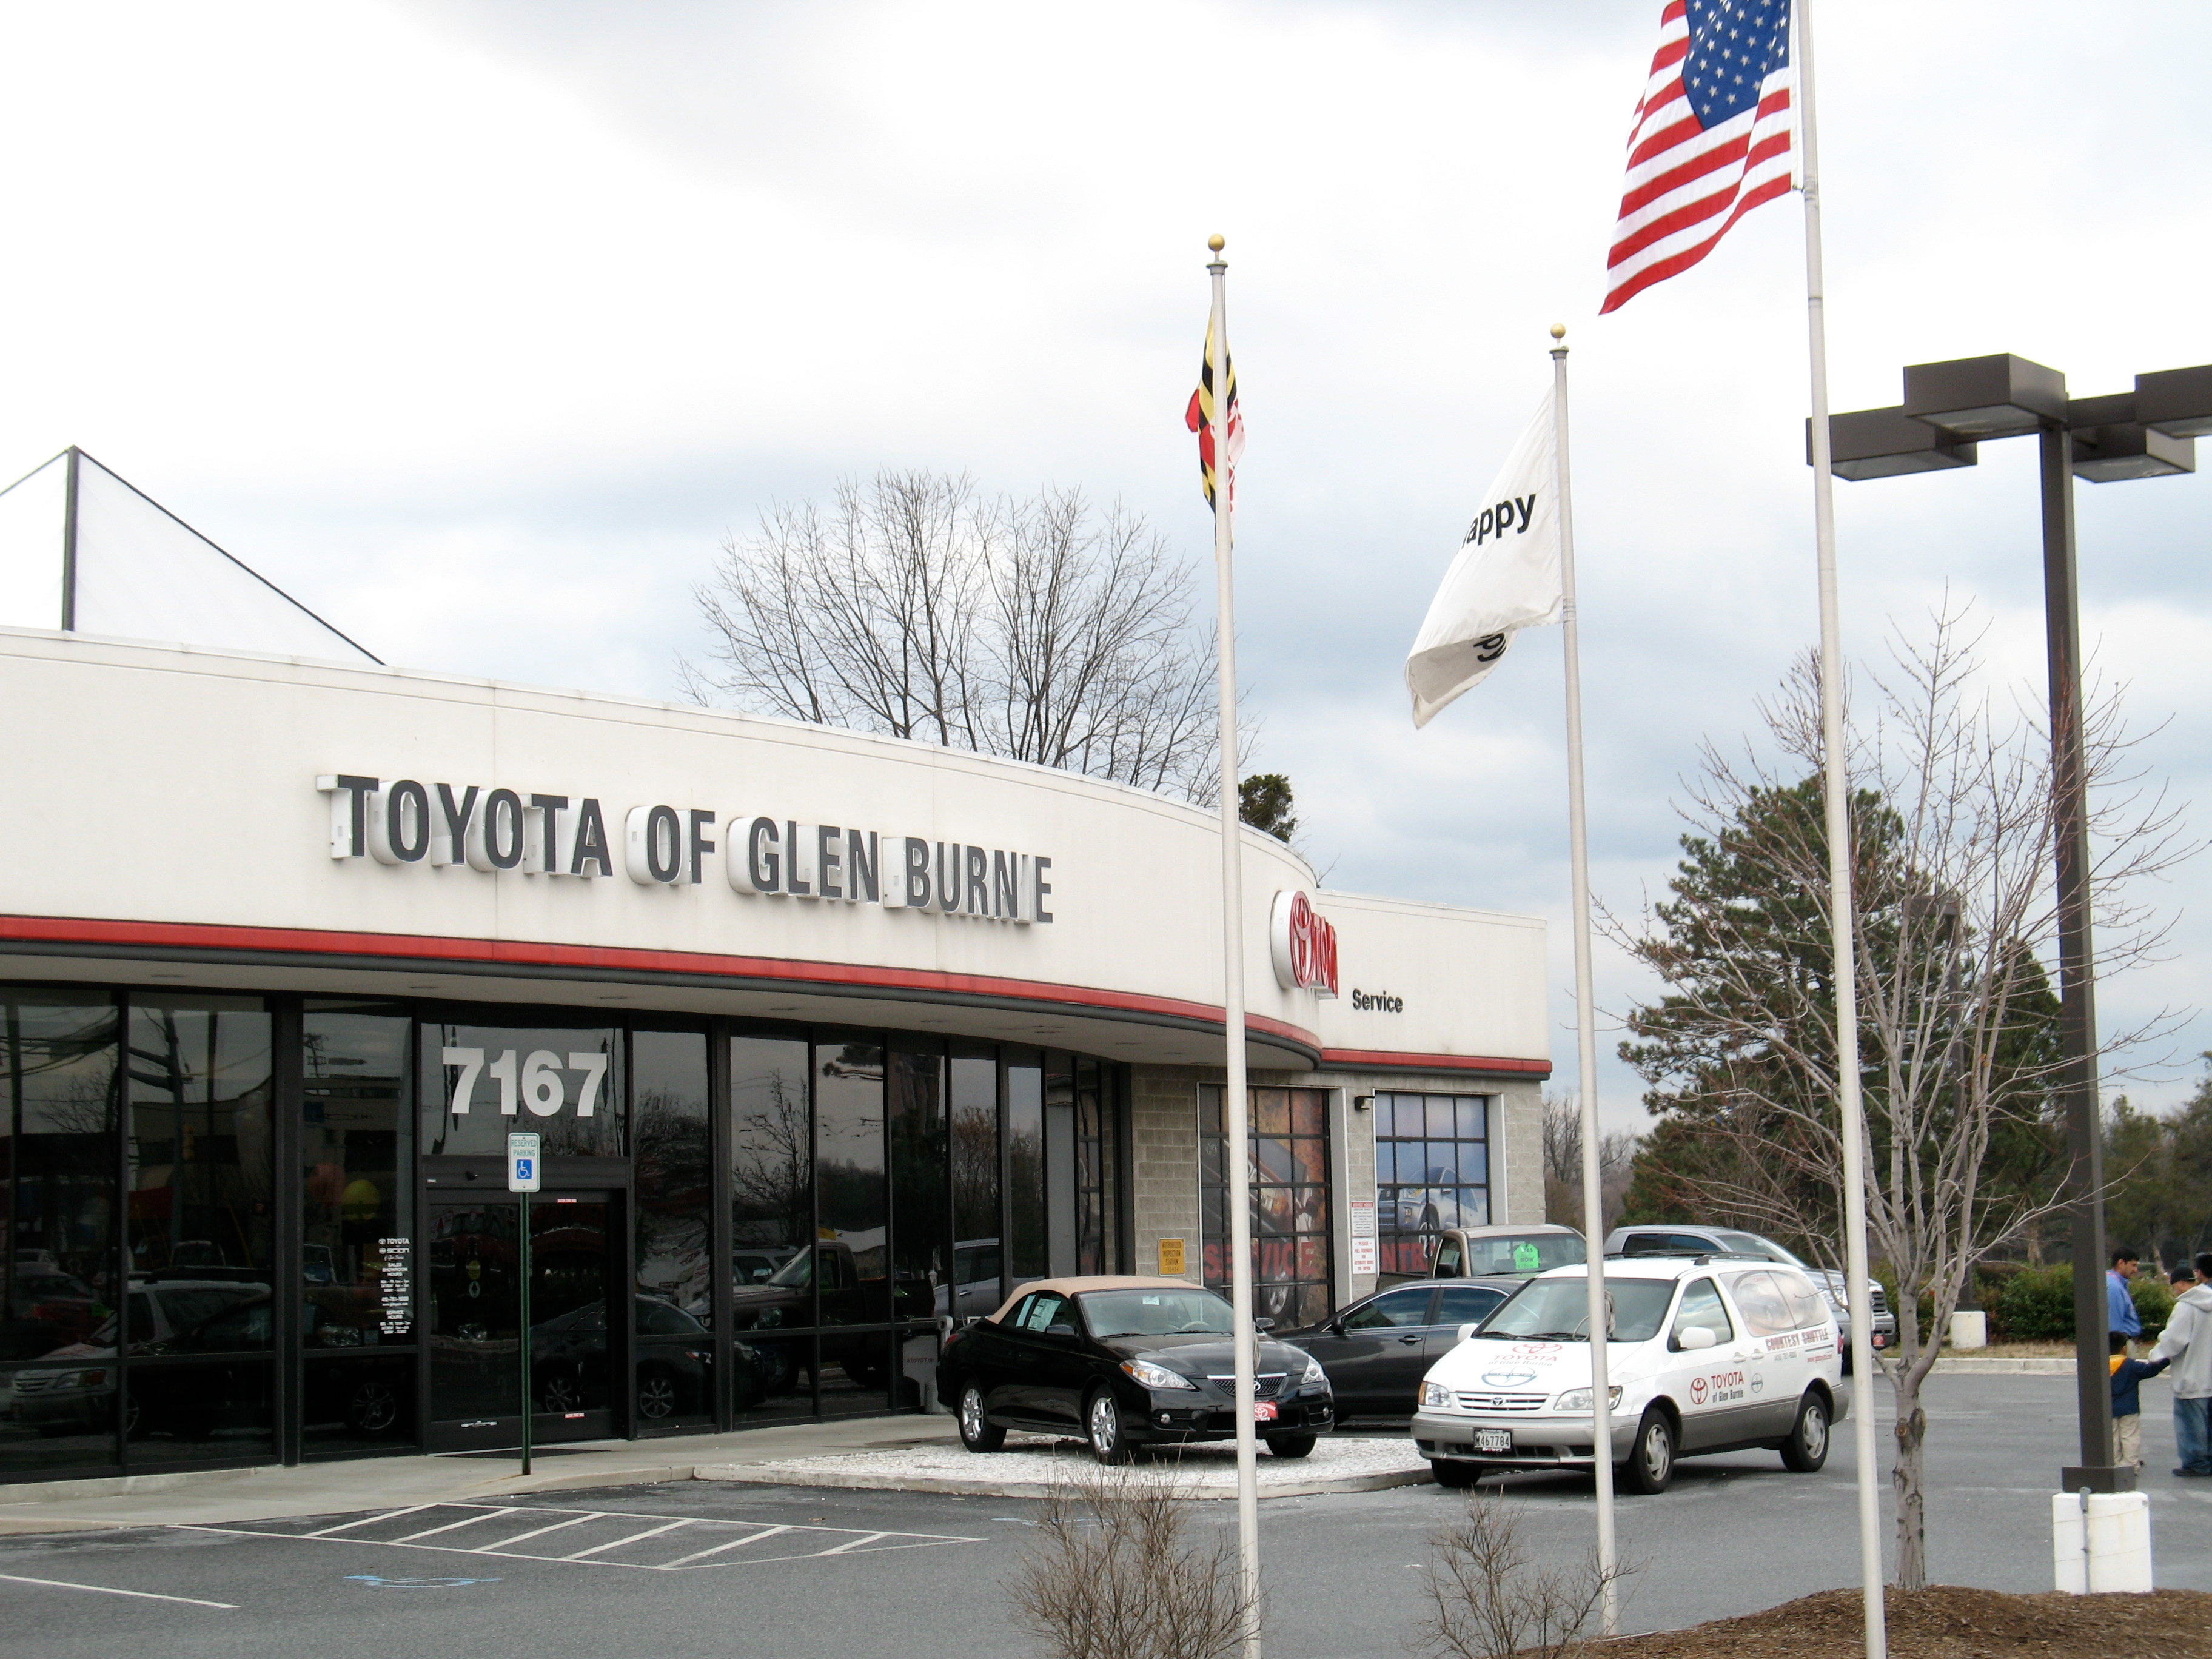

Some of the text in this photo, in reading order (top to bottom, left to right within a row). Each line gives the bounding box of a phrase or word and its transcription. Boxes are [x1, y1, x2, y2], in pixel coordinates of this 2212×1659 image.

[1461, 494, 1537, 549] appy
[332, 774, 1054, 924] TOYOTA OF GLEN BURNIE
[1352, 988, 1404, 1013] Service
[442, 1046, 608, 1118] 7167
[513, 1148, 535, 1157] PARKING
[1204, 1242, 1316, 1279] SEVICE
[1711, 1370, 1744, 1390] TOYOTA
